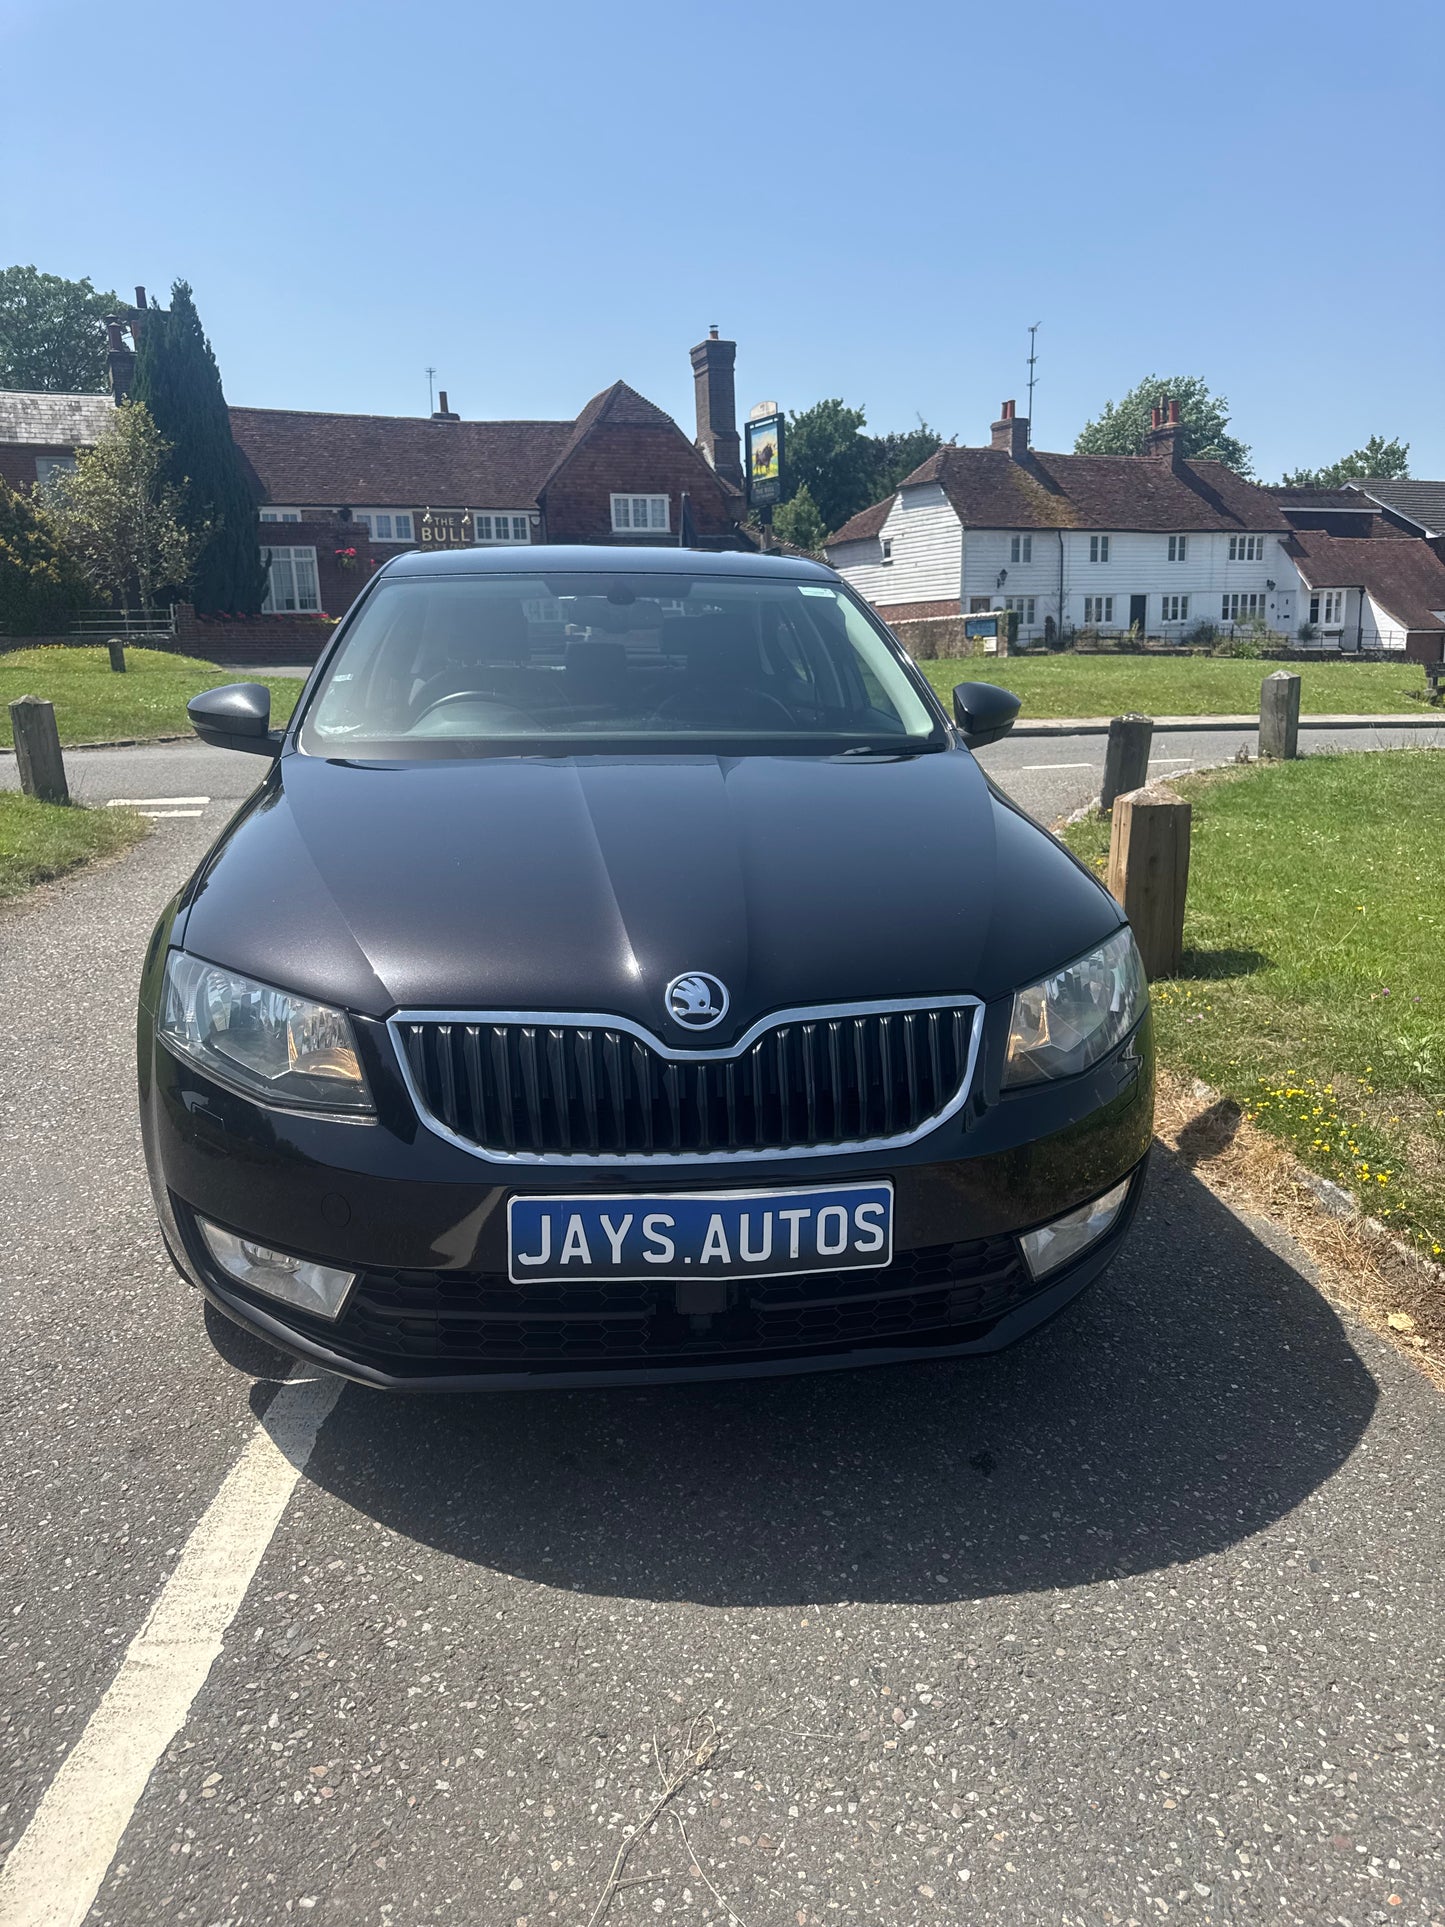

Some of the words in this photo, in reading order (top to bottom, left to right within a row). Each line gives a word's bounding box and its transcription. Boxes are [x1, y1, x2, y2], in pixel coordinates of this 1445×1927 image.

[434, 517, 455, 526] THE
[421, 527, 470, 541] BULL
[517, 1202, 885, 1266] JAYS.AUTOS
